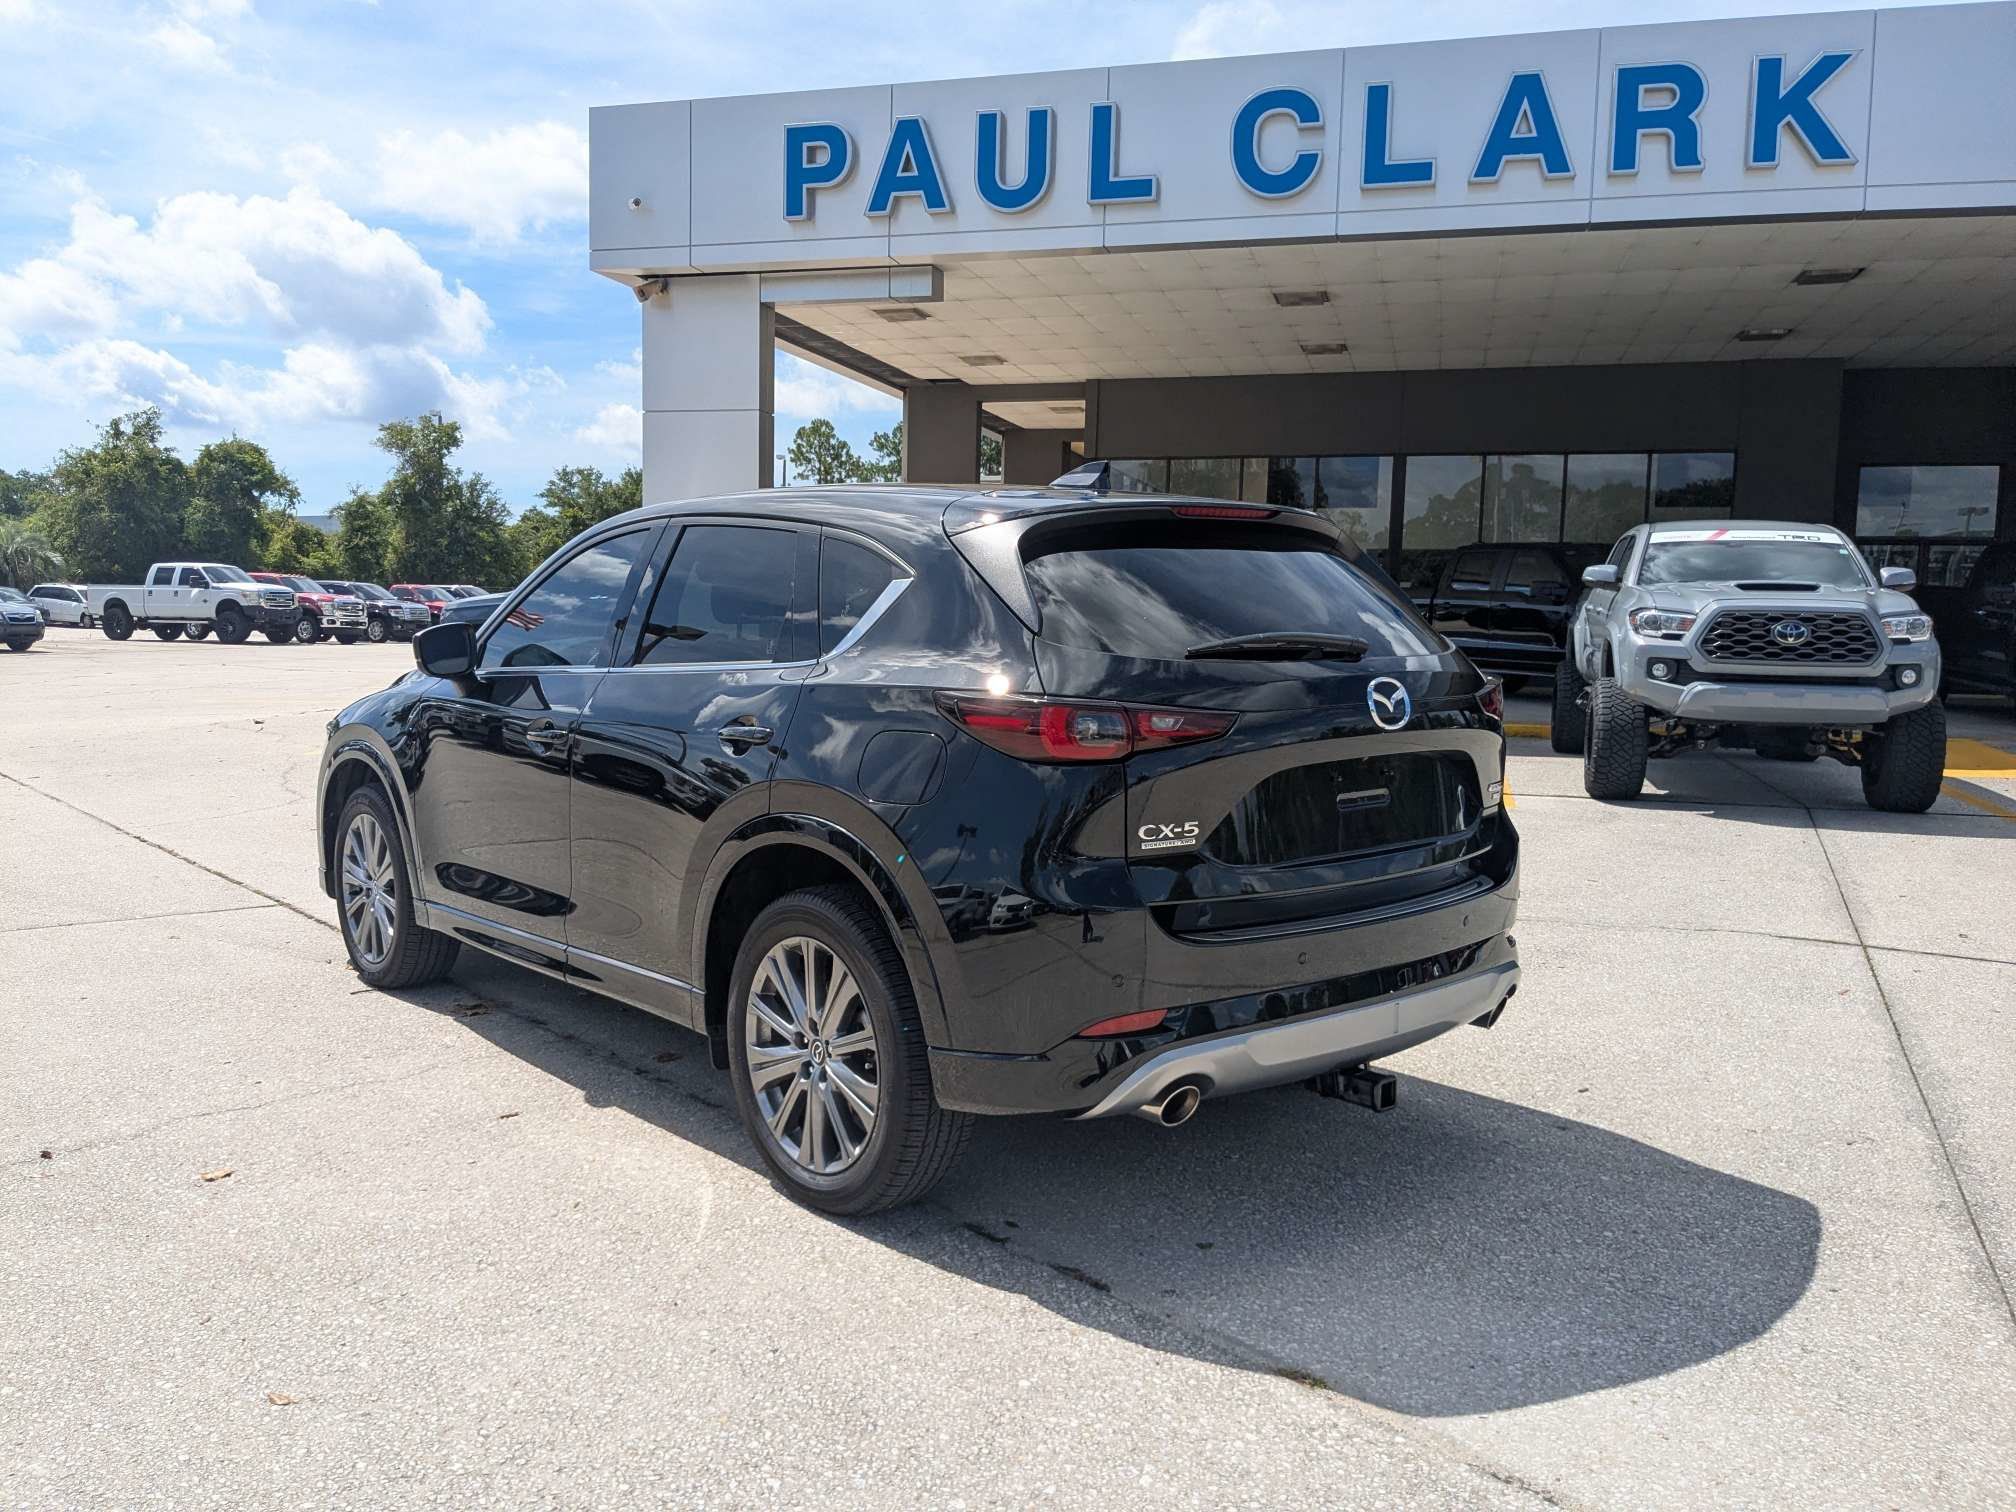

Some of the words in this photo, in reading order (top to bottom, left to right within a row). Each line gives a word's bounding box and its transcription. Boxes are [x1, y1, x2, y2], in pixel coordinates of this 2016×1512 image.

[783, 101, 1159, 221] PAUL
[1230, 49, 1861, 199] CLARK
[1777, 534, 1821, 542] TRD
[1138, 821, 1200, 840] CX-5
